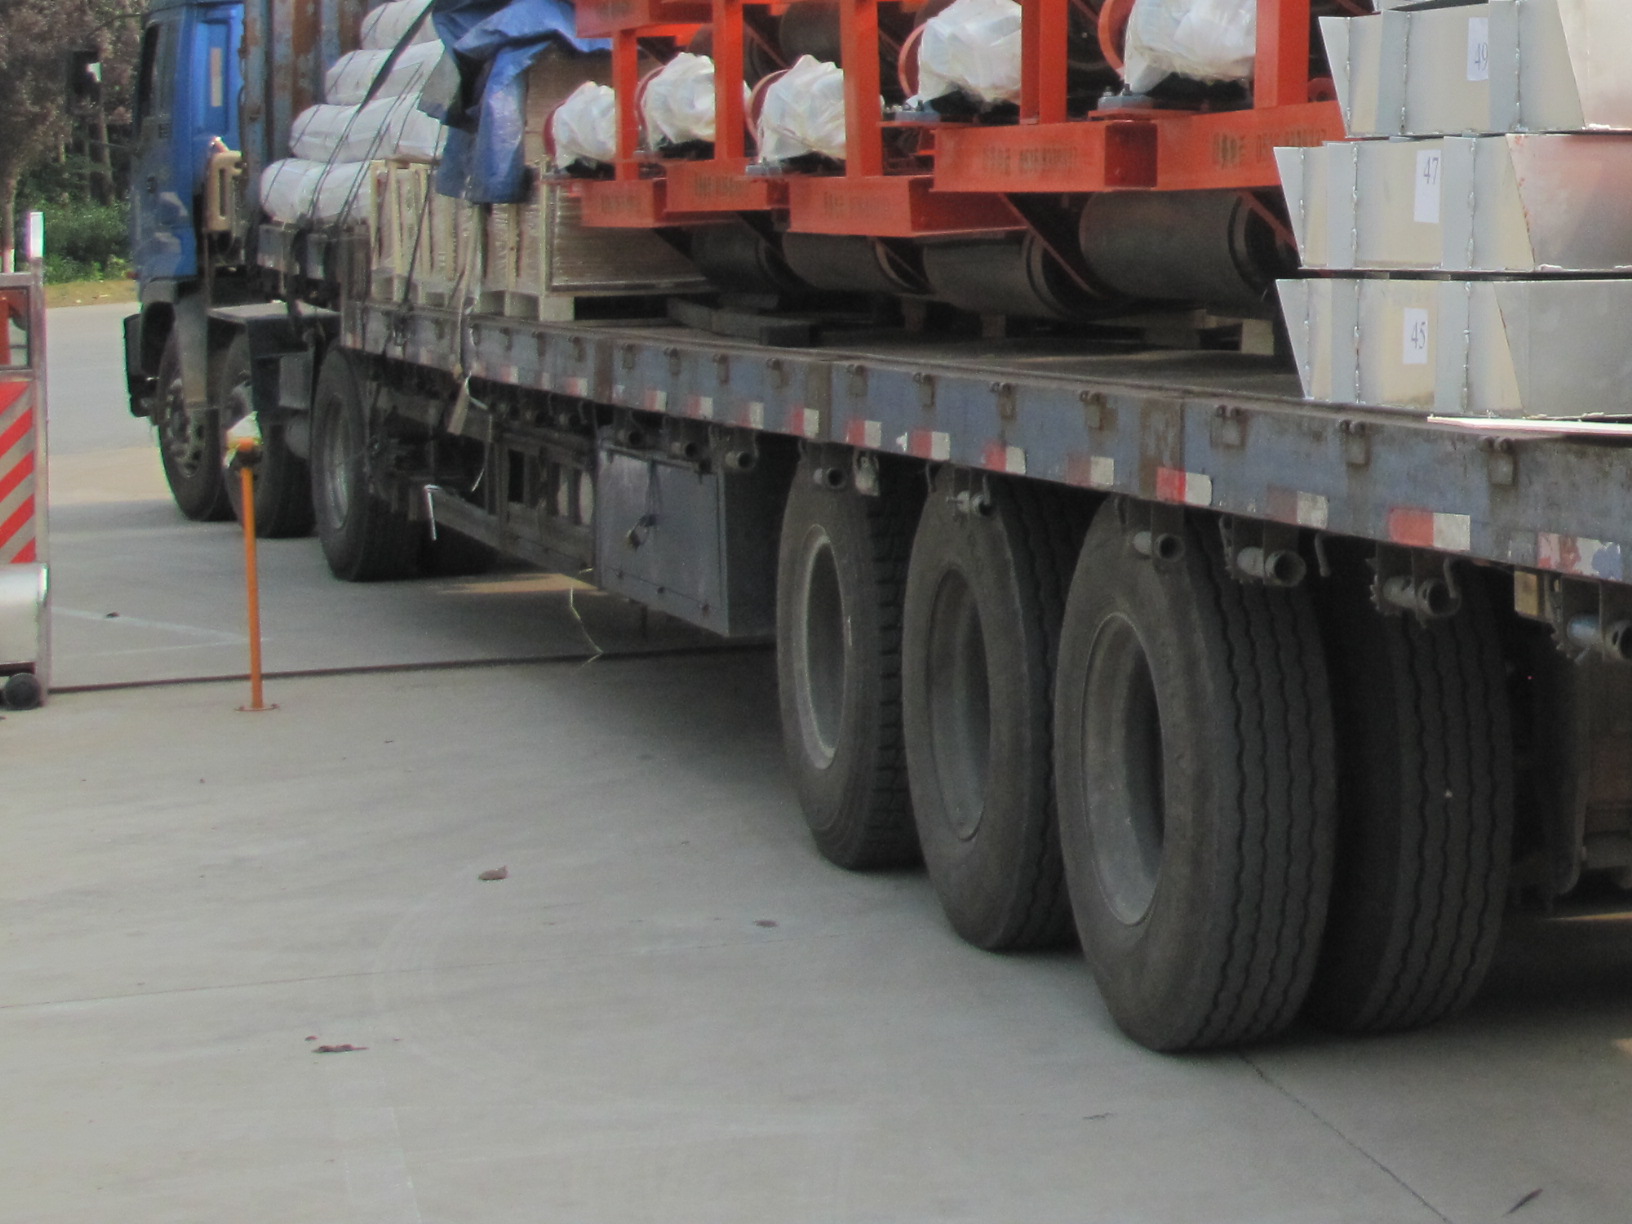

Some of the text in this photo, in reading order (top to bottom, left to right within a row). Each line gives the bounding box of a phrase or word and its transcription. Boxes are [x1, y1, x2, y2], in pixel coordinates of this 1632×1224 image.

[1474, 43, 1488, 71] 49
[1423, 157, 1439, 185] 47
[1411, 321, 1425, 350] 45
